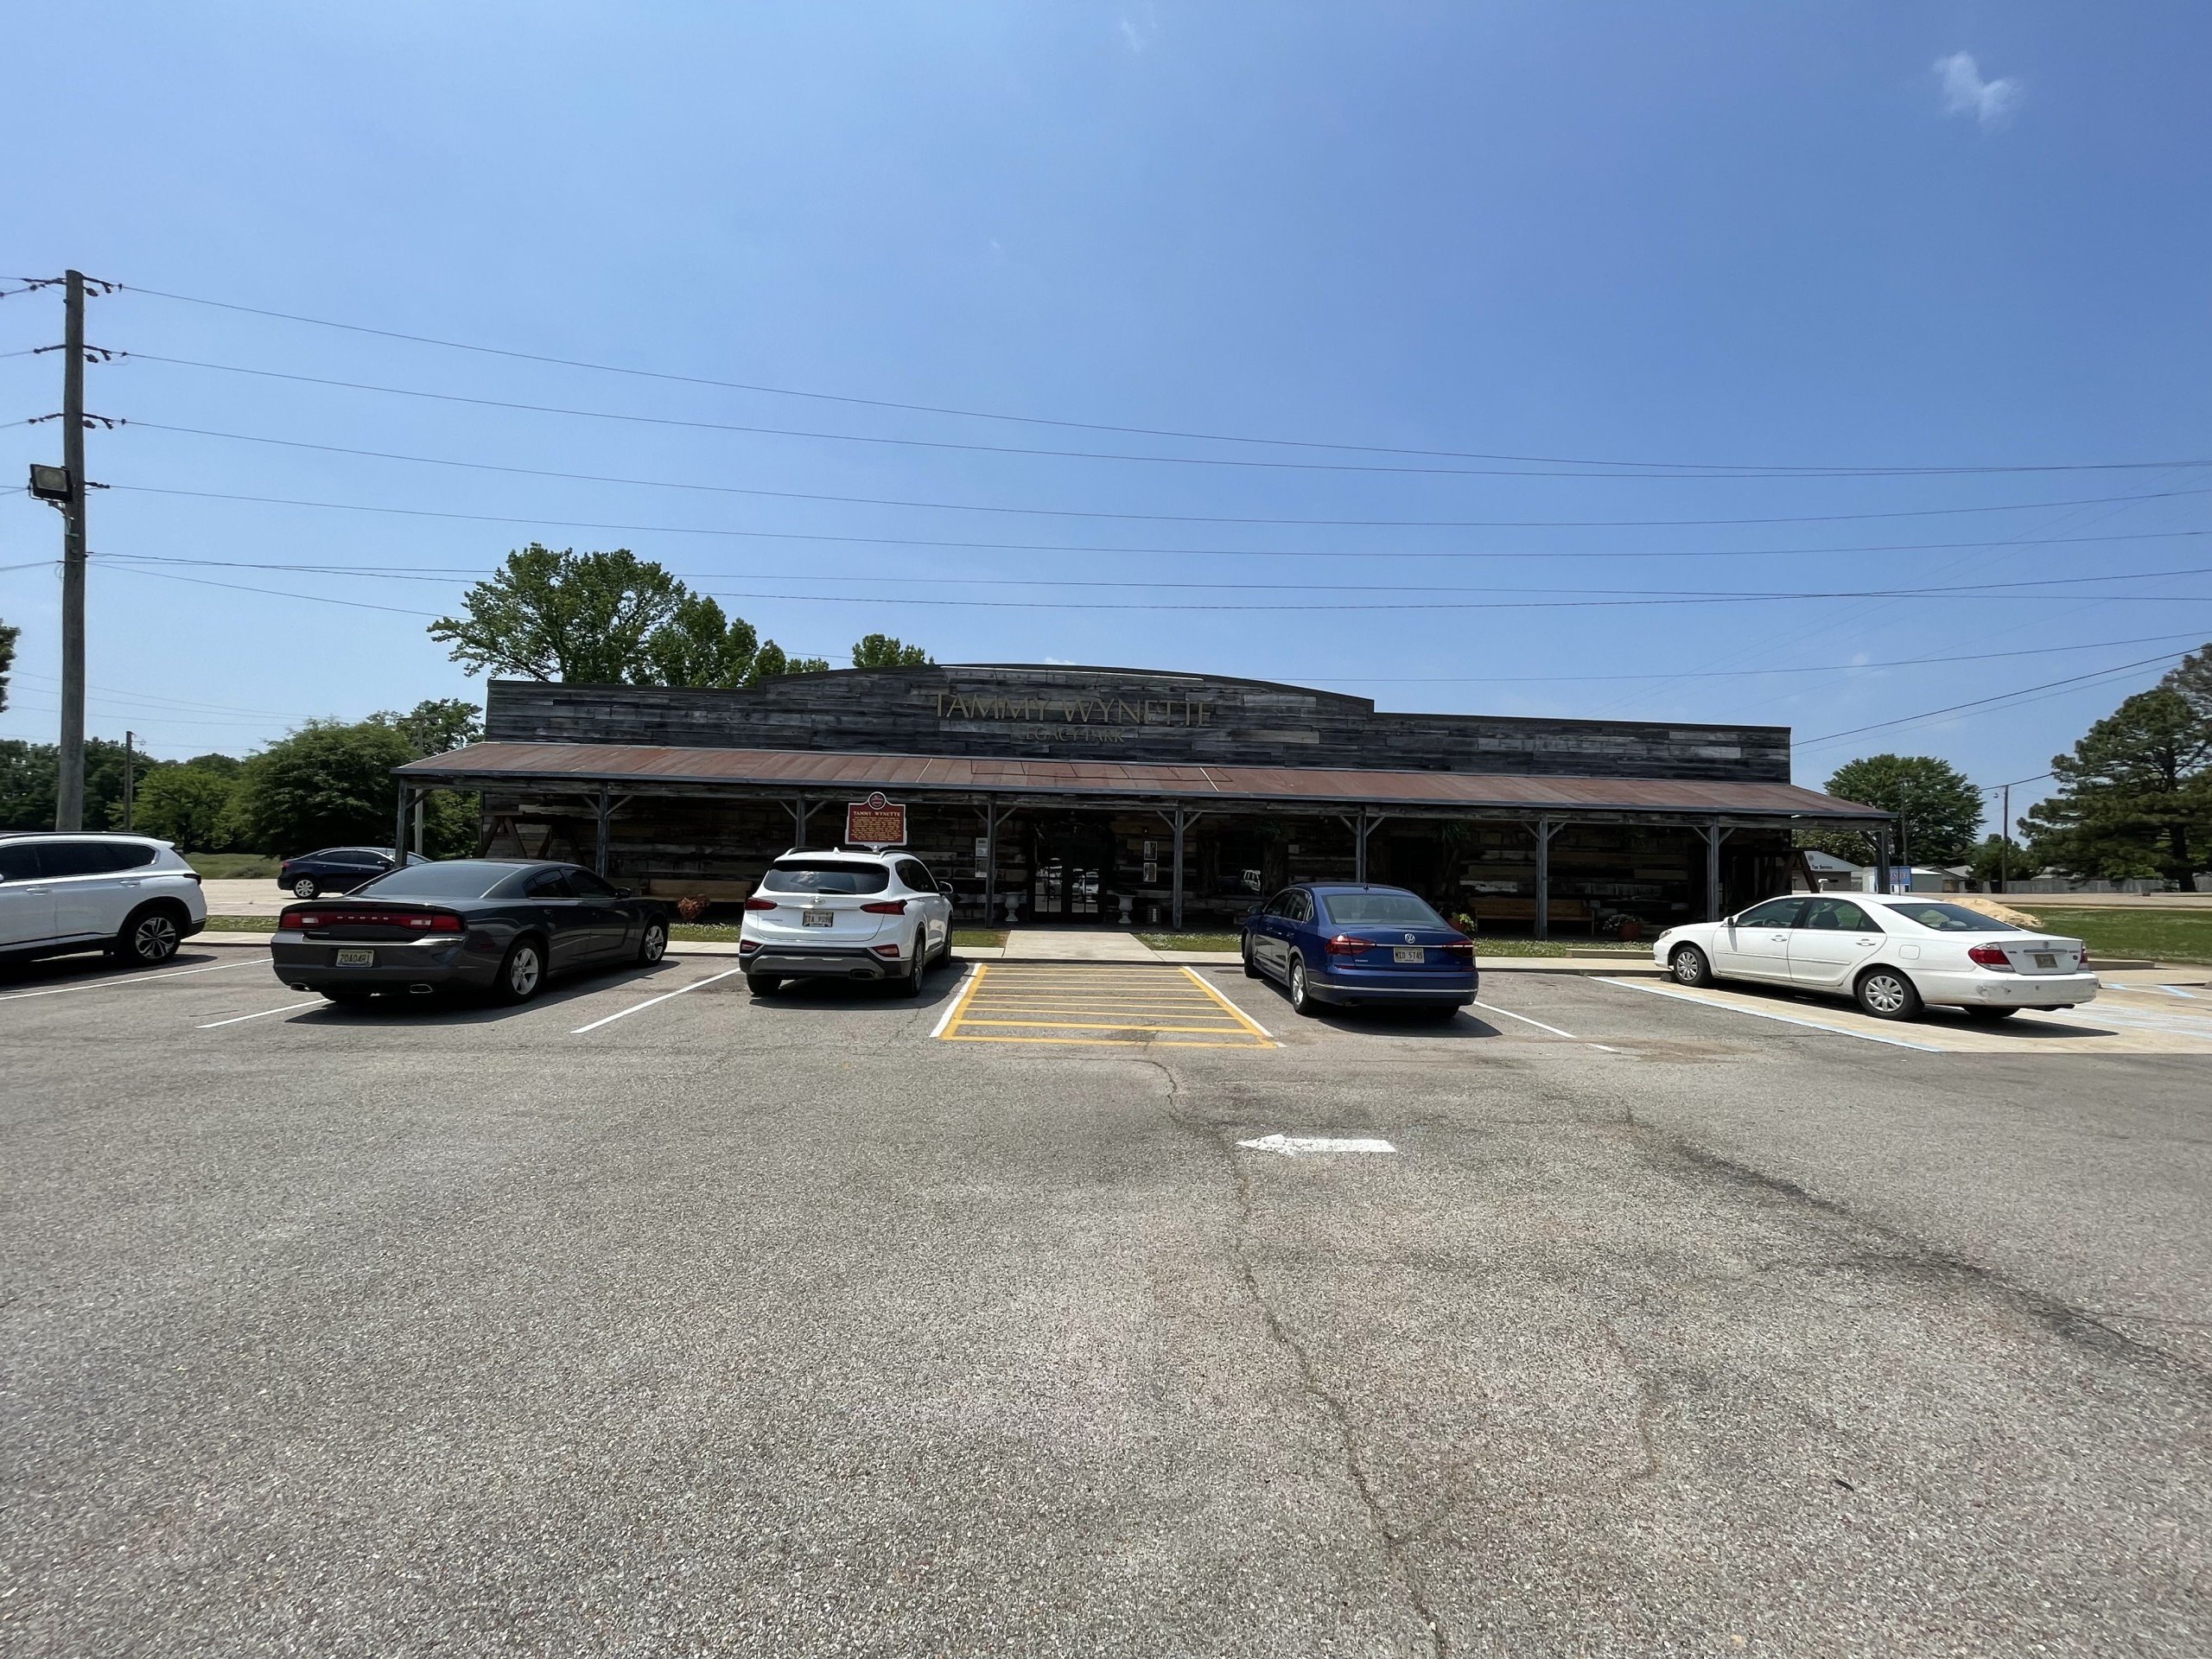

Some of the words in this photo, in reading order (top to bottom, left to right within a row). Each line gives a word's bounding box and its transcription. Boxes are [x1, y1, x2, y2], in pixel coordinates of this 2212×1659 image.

[935, 692, 1052, 721] TAMMY
[1060, 698, 1211, 728] WYNETTE
[1018, 724, 1081, 741] LEGACY
[1084, 725, 1125, 743] PARK
